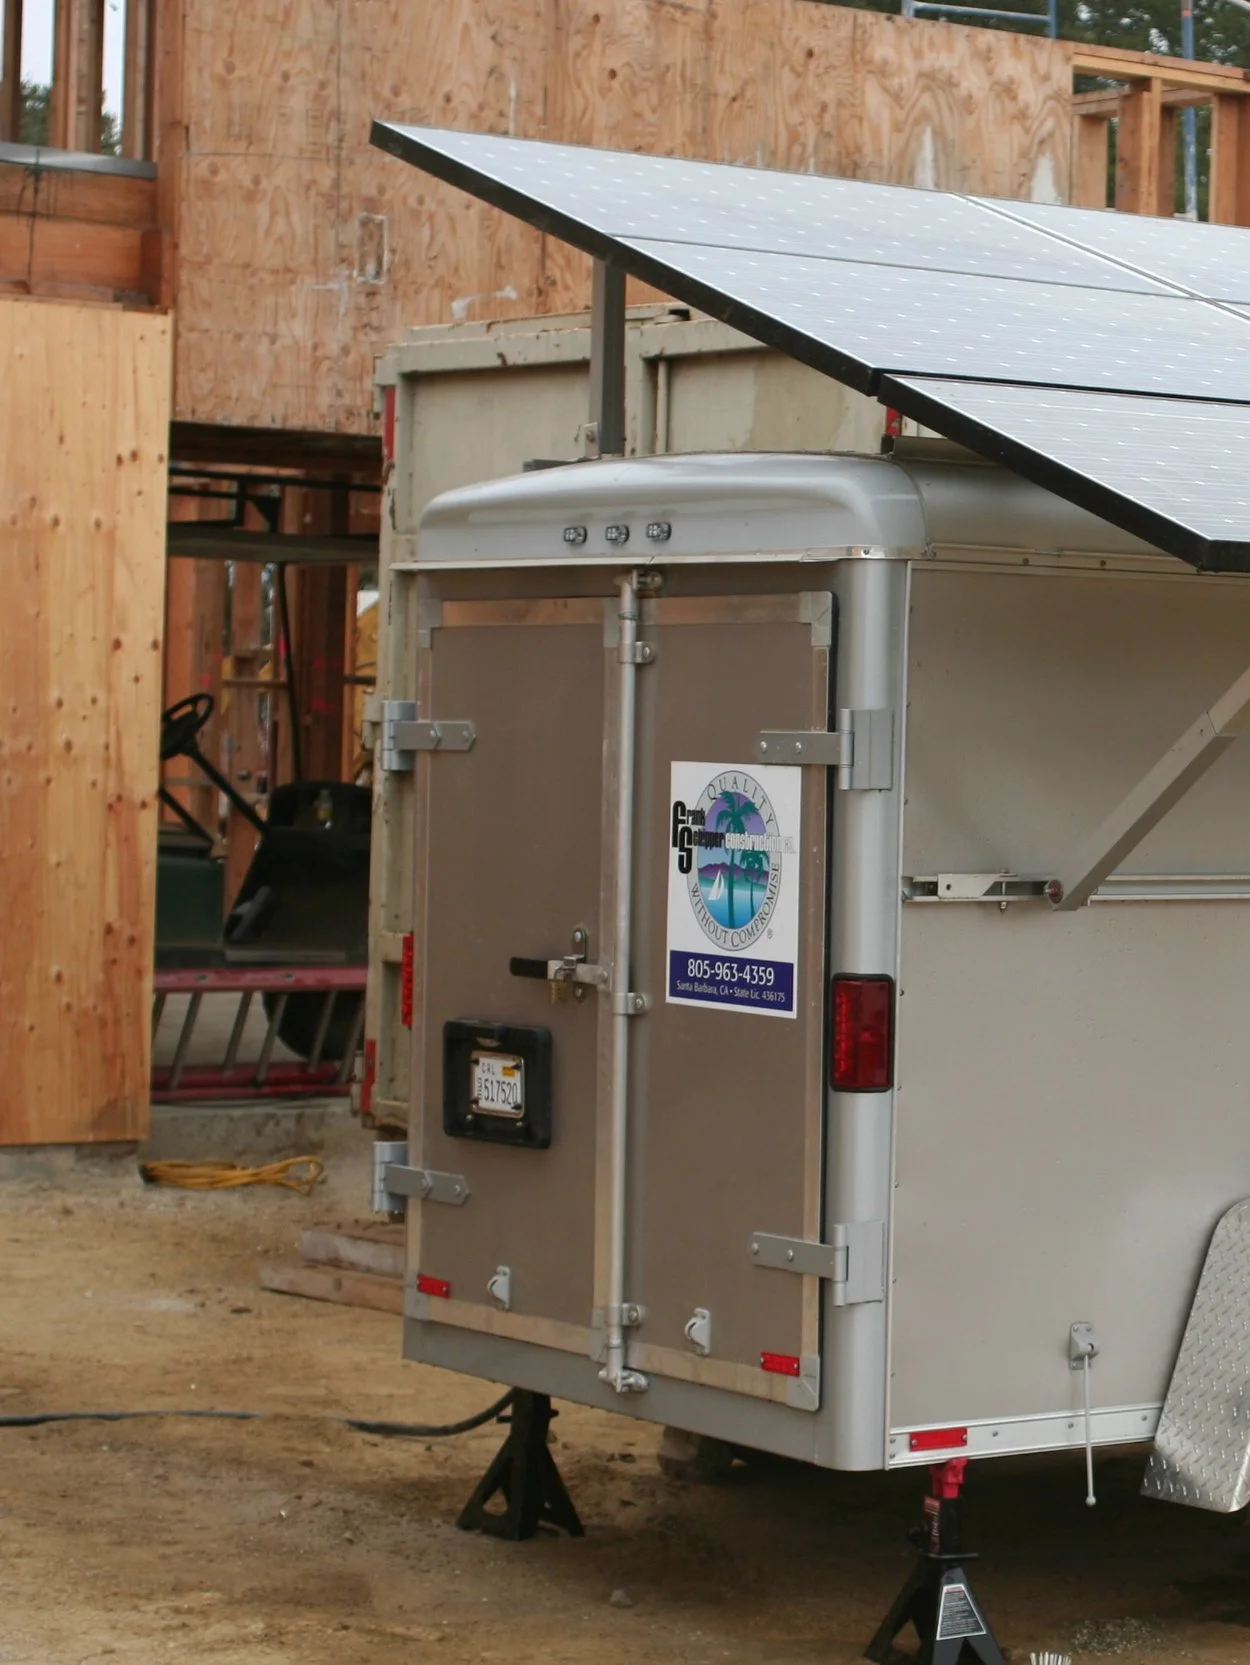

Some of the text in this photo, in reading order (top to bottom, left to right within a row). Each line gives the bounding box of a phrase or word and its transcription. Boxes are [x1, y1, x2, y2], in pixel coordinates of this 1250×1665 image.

[706, 776, 774, 825] QUALITY
[690, 862, 780, 948] WITHOUT COMPROMISE
[687, 958, 775, 986] 805-963-4359
[676, 980, 694, 992] Santa
[694, 982, 719, 996] Barbara,
[719, 985, 729, 996] CA
[733, 988, 750, 999] State
[762, 991, 786, 1003] 436175
[484, 1078, 518, 1104] 517520
